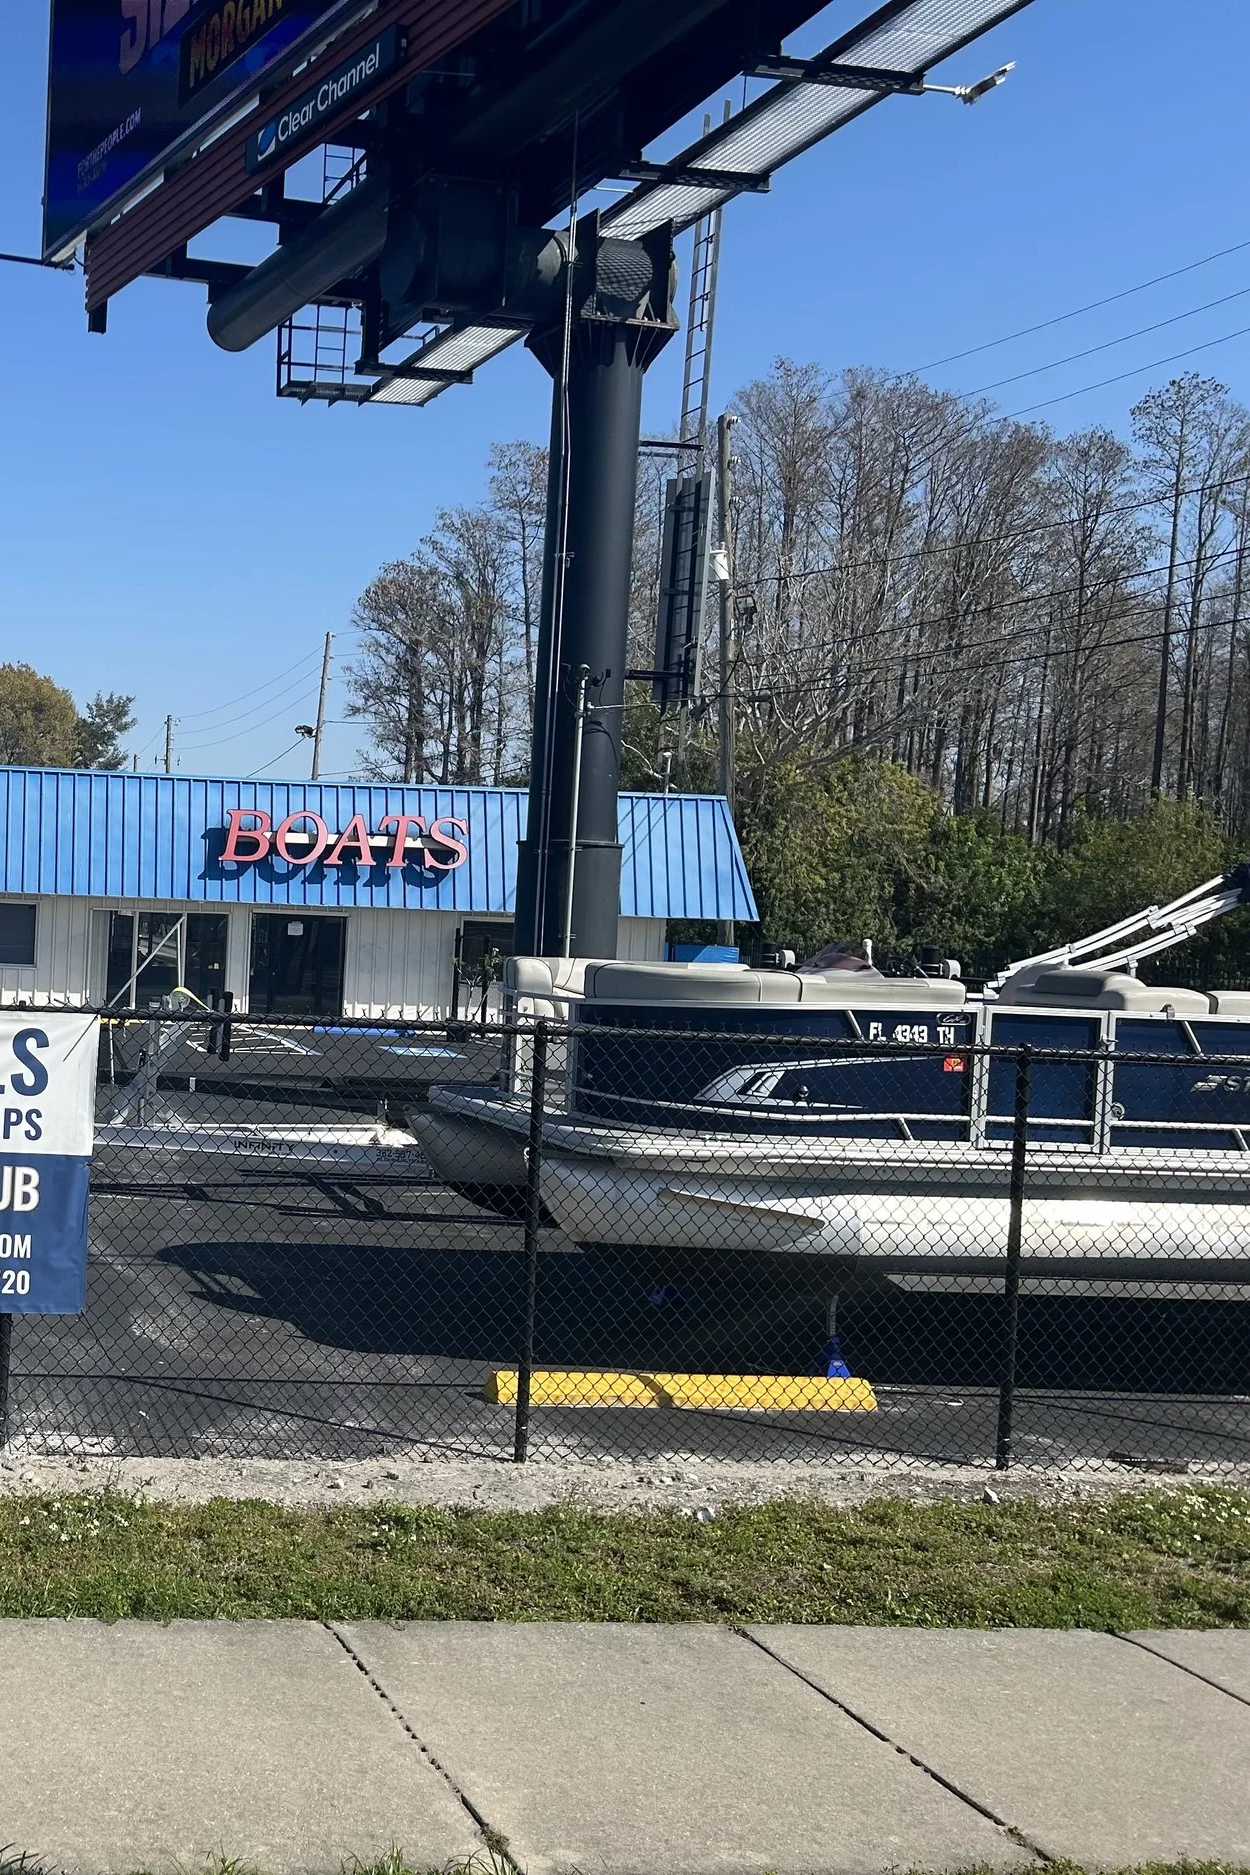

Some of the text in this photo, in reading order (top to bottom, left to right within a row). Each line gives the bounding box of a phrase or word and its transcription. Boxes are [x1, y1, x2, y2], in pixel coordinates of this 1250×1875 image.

[278, 43, 380, 141] Clear Channel
[218, 808, 469, 870] BOATS
[869, 1022, 955, 1045] FL 4343 TH
[234, 1141, 295, 1152] INFINITY
